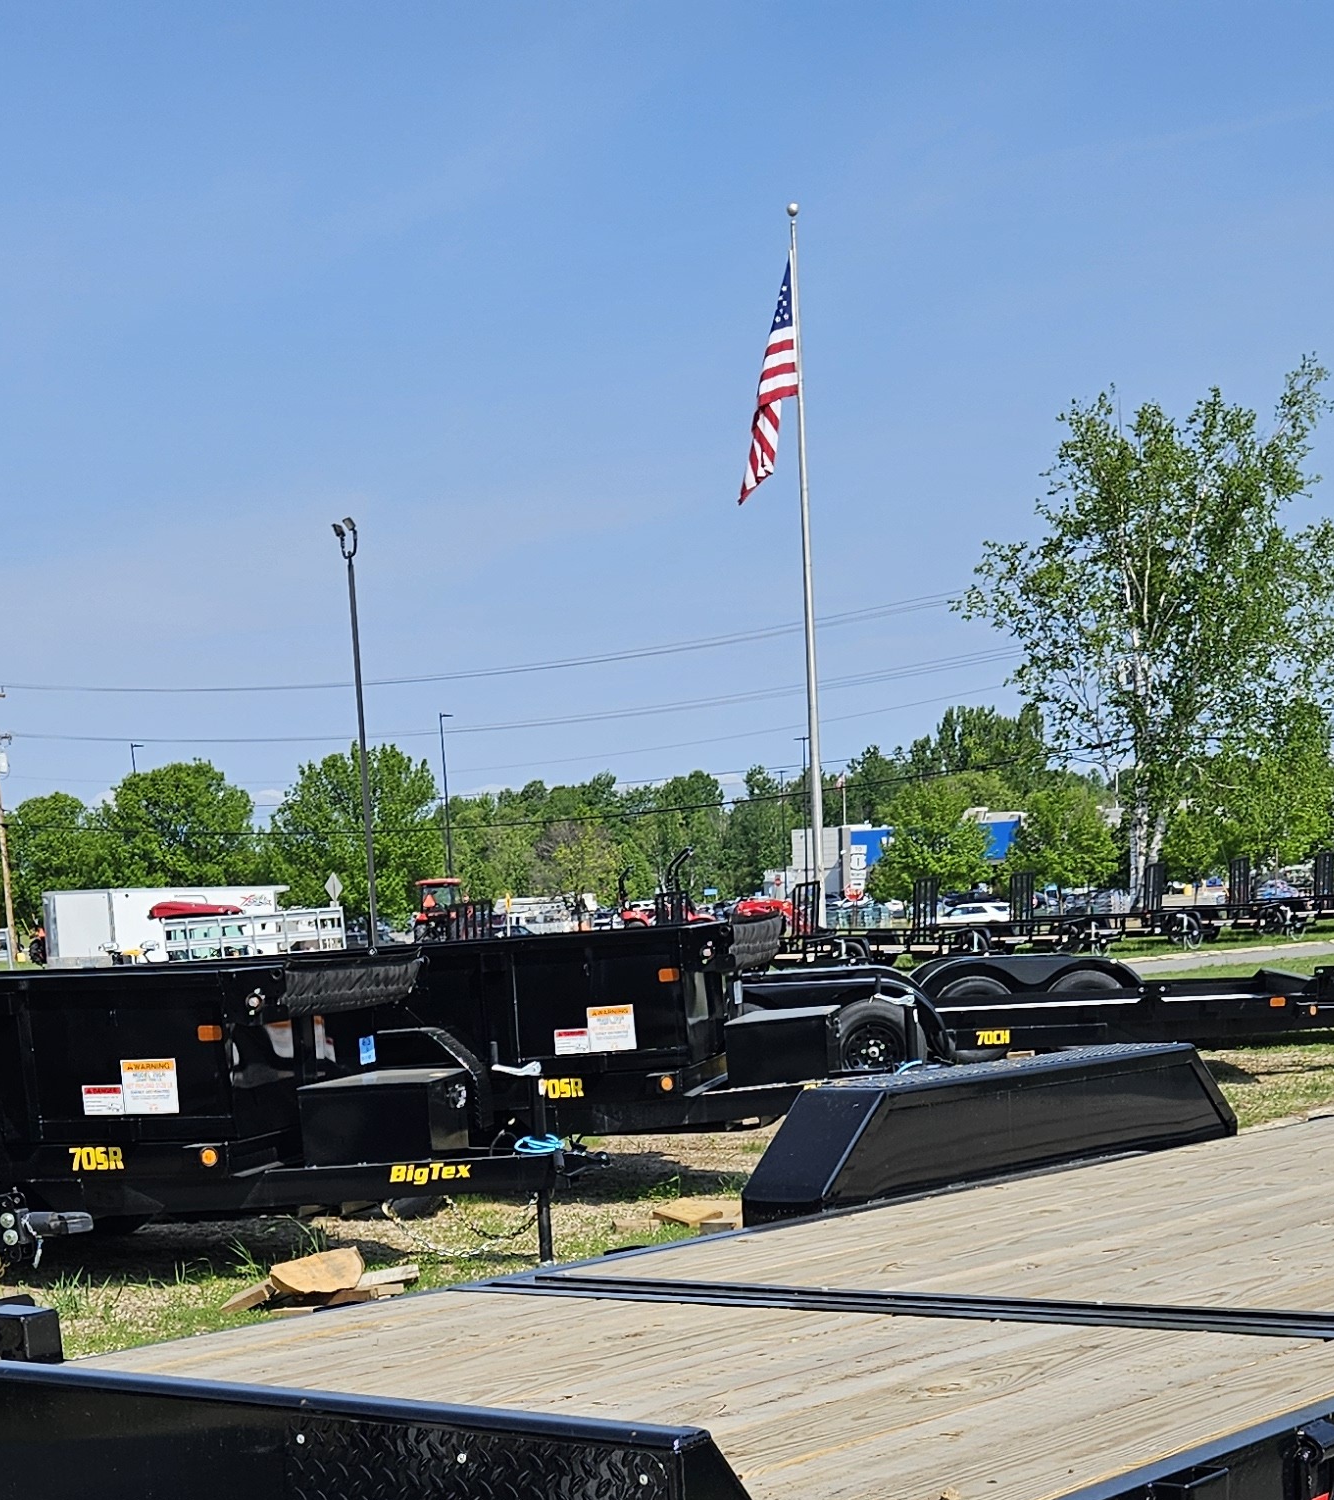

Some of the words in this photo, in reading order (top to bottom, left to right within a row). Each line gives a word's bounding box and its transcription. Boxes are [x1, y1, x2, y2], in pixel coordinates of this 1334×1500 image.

[976, 1030, 1010, 1045] 70CH
[133, 1062, 170, 1070] WARNING
[69, 1147, 124, 1171] 70SR
[390, 1162, 471, 1185] BigTex
